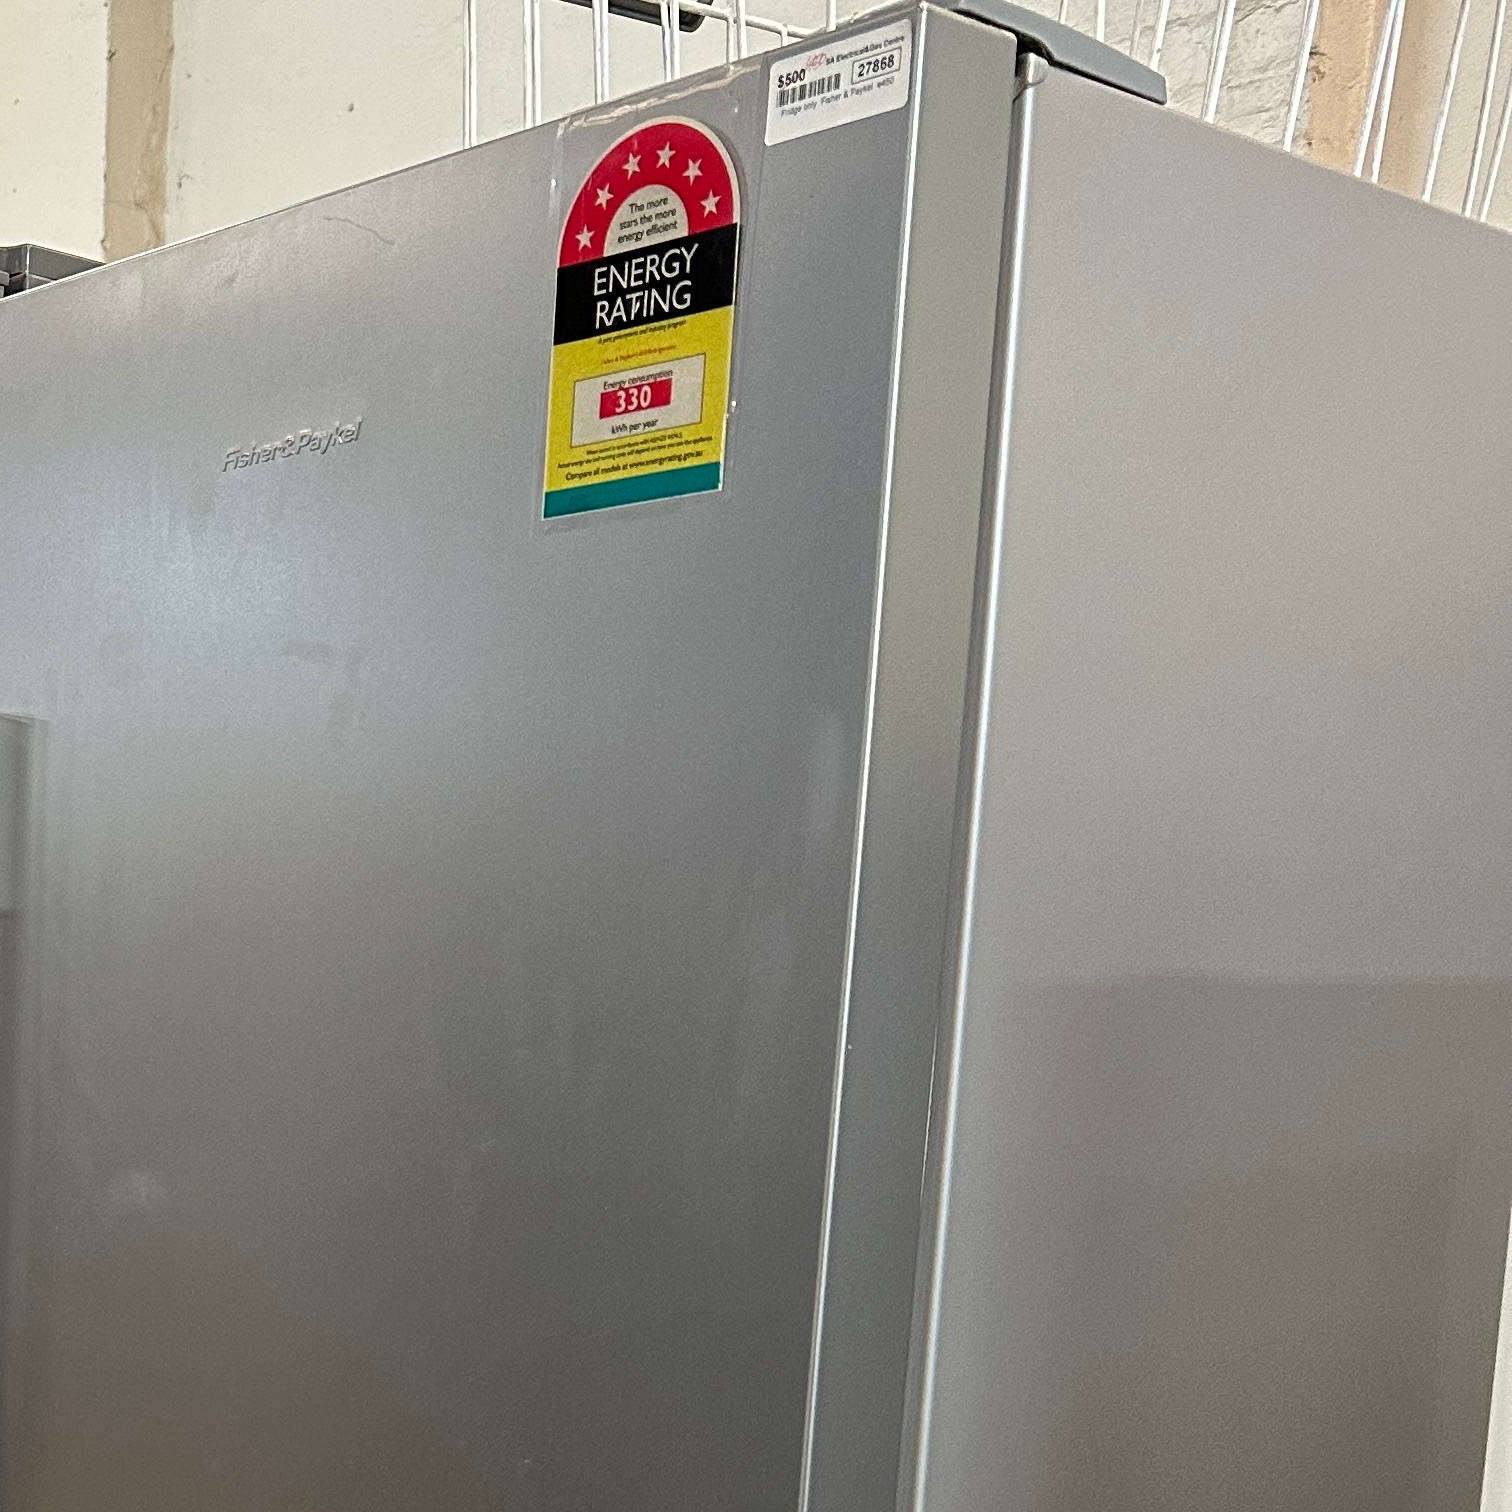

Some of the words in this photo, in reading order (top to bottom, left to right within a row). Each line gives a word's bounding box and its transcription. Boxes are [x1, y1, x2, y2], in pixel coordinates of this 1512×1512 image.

[857, 54, 895, 78] 27868
[777, 68, 806, 89] $500
[629, 203, 644, 214] The
[647, 197, 668, 210] more
[620, 219, 638, 230] stars
[640, 214, 653, 225] the
[655, 208, 676, 220] more
[617, 230, 644, 244] energy
[646, 220, 678, 236] efficient
[593, 243, 699, 296] ENERGY
[595, 280, 692, 329] RATING
[604, 381, 626, 390] Energy
[628, 370, 673, 385] consumption
[615, 385, 652, 413] 330
[611, 424, 628, 435] kWh
[629, 422, 641, 434] per
[642, 419, 658, 431] year
